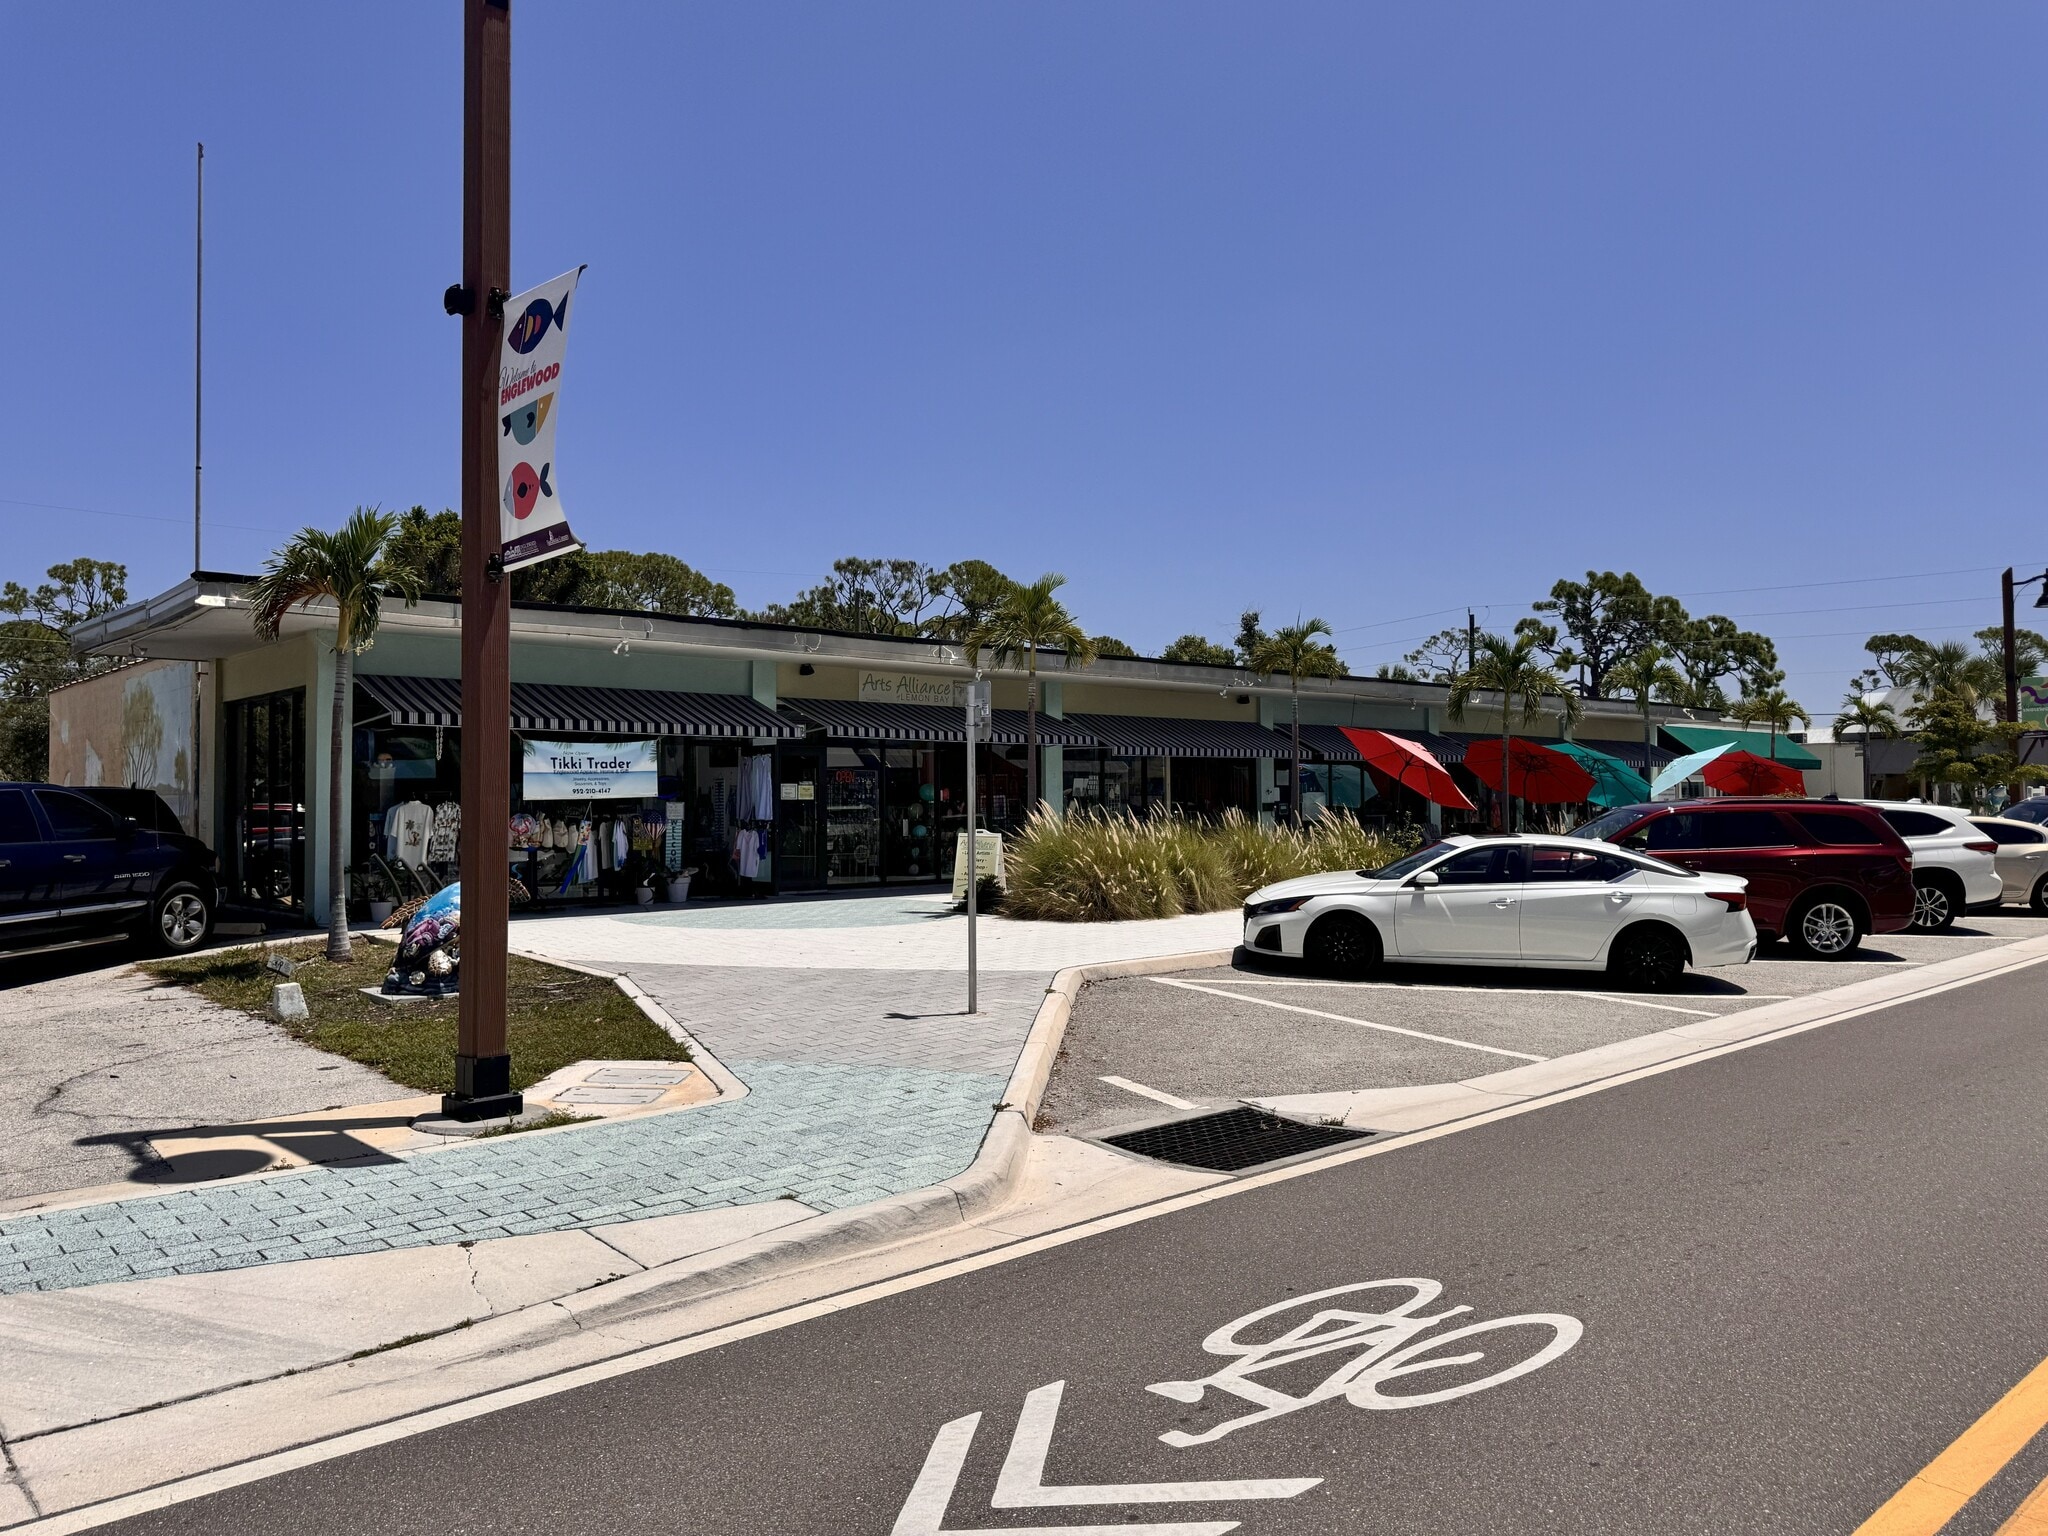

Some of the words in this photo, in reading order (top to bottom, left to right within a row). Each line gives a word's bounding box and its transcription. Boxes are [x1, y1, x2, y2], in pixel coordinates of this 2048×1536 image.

[499, 366, 530, 389] Welcome
[530, 360, 536, 374] to
[501, 362, 560, 406] ENGLEWOOD
[862, 673, 892, 692] Arts
[896, 676, 951, 695] Alliance
[901, 693, 930, 702] LEMON
[934, 696, 950, 704] BAY
[550, 756, 582, 770] Tikki
[587, 756, 631, 769] Trader
